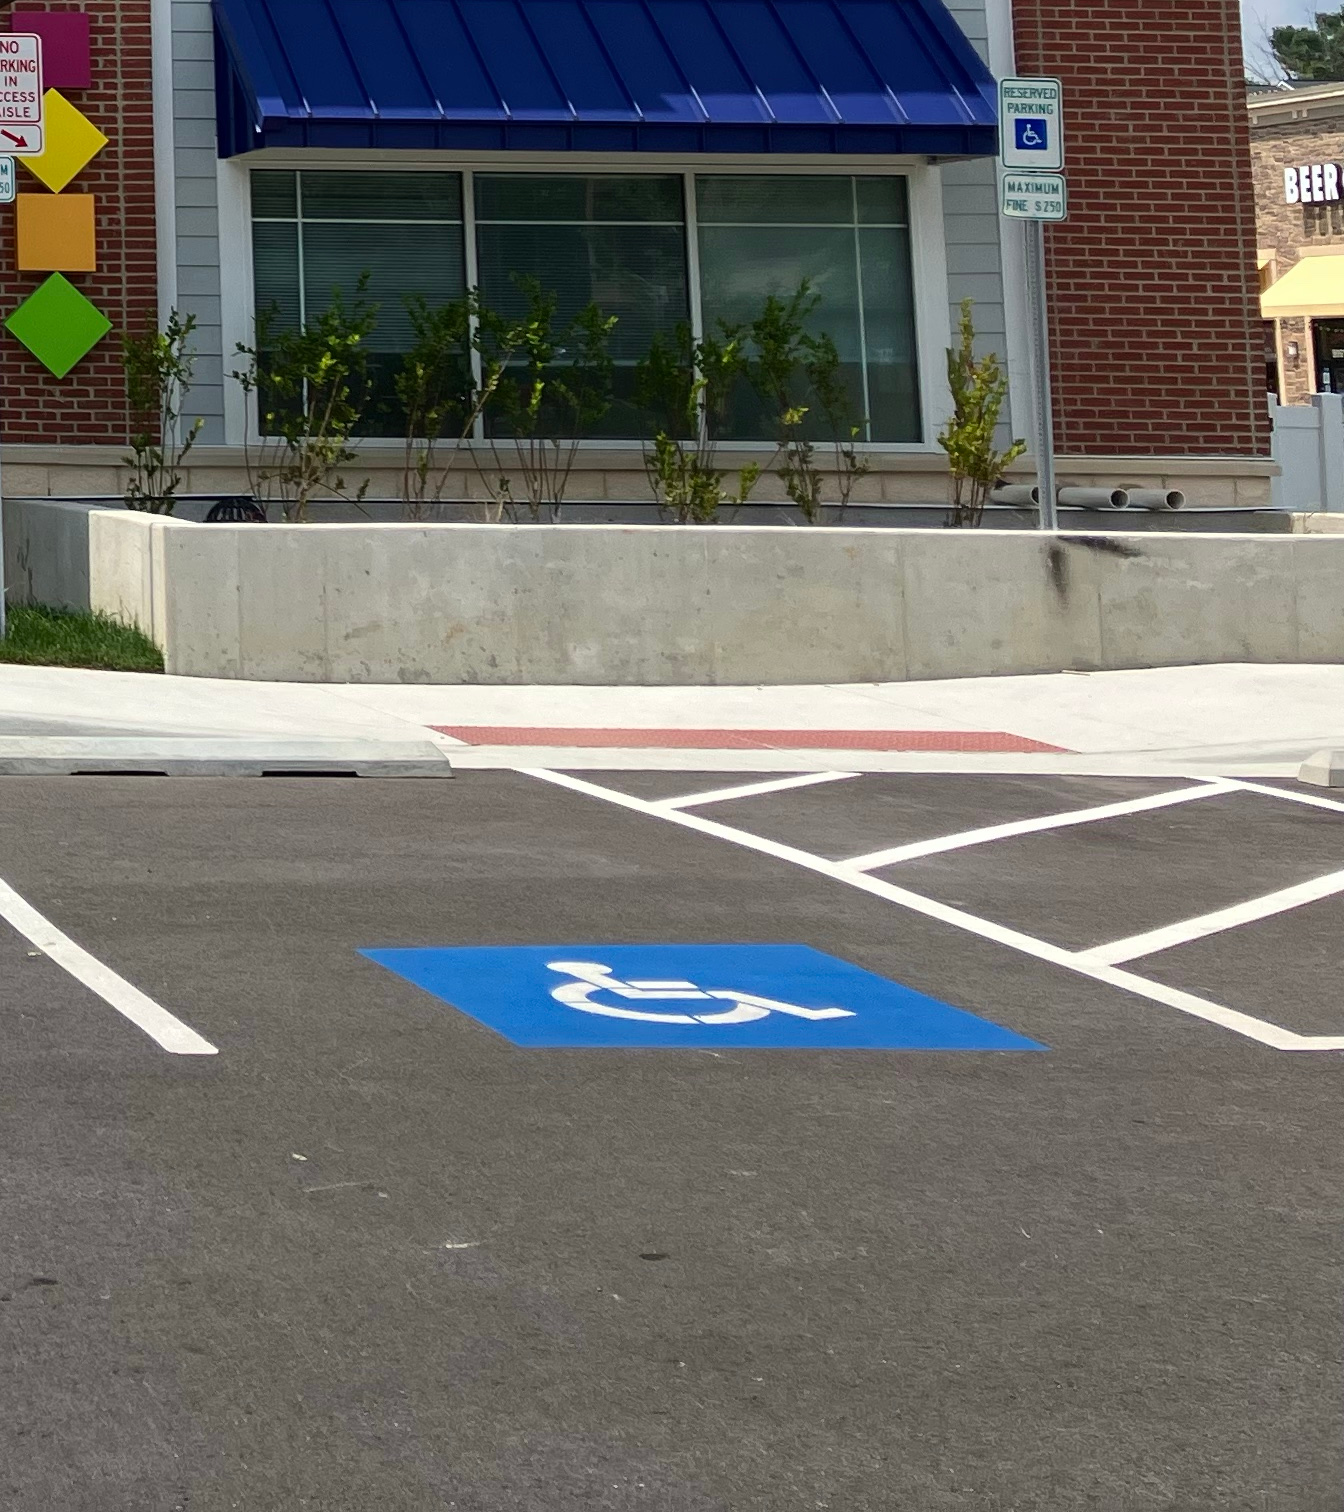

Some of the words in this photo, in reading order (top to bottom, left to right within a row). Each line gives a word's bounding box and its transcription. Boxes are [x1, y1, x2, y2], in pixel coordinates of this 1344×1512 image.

[0, 41, 19, 54] NO
[4, 76, 18, 87] IN
[1004, 87, 1057, 100] RESERVED
[1007, 103, 1054, 115] PARKING
[1007, 181, 1059, 194] MAXIMUM
[1284, 163, 1339, 204] BEER
[1006, 199, 1028, 212] FINE
[1035, 200, 1062, 213] $250
